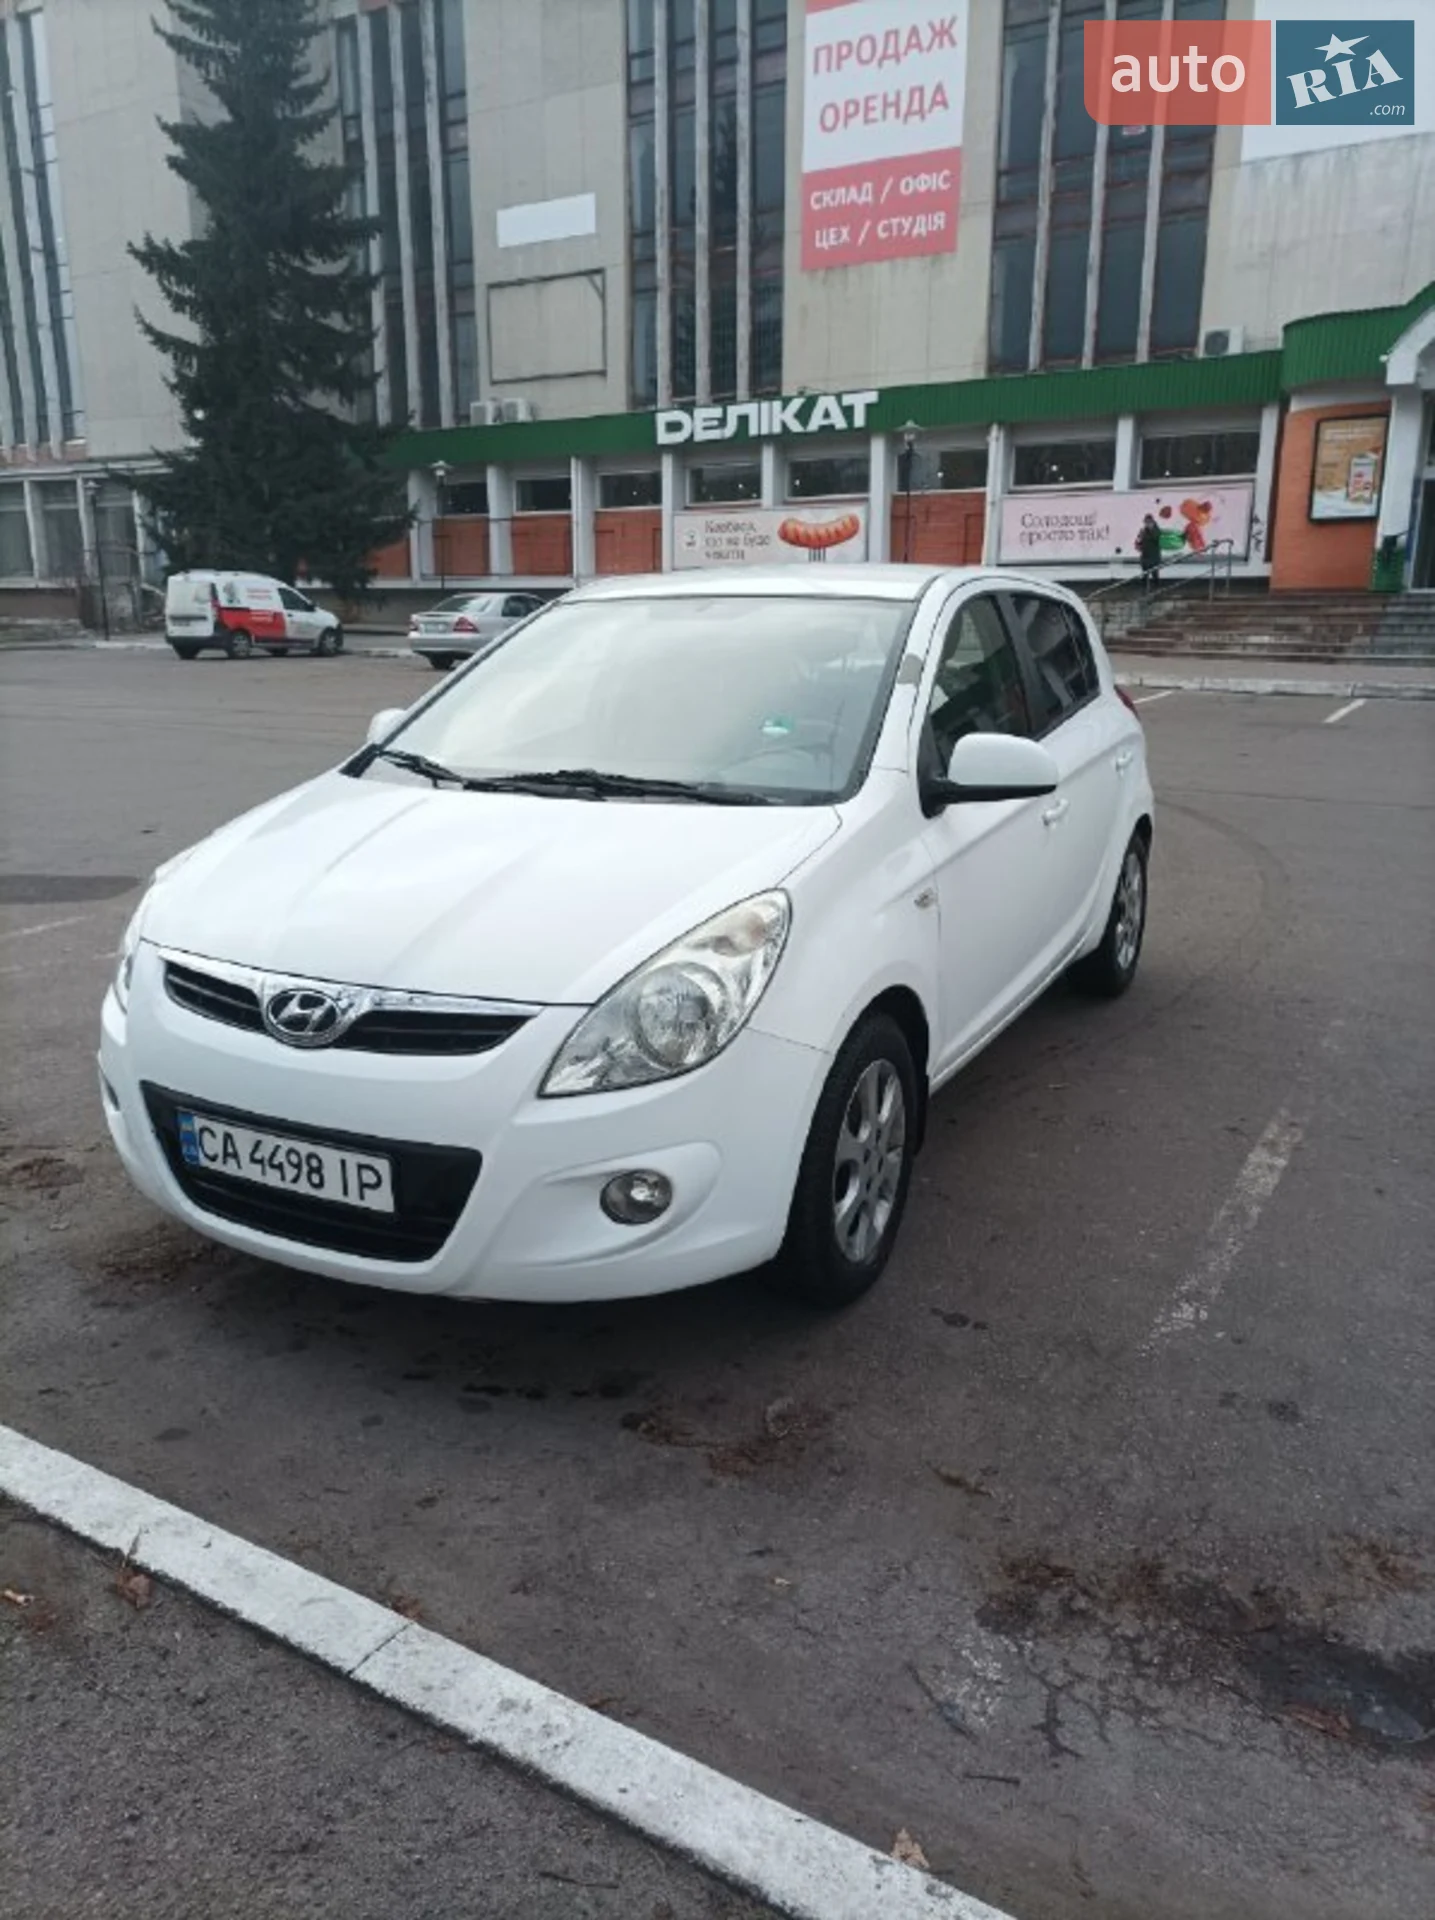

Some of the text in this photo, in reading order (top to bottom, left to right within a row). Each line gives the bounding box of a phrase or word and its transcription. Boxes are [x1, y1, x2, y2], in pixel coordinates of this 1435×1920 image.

[813, 16, 957, 75] ПРОДАЖ
[819, 81, 950, 133] ОРЕНДА
[810, 182, 873, 210] СКЛАД
[900, 169, 951, 196] ОФІС
[815, 225, 850, 250] ЦЕХ
[877, 211, 946, 239] СТУДІЯ
[199, 1126, 382, 1201] CA 4498 IP
